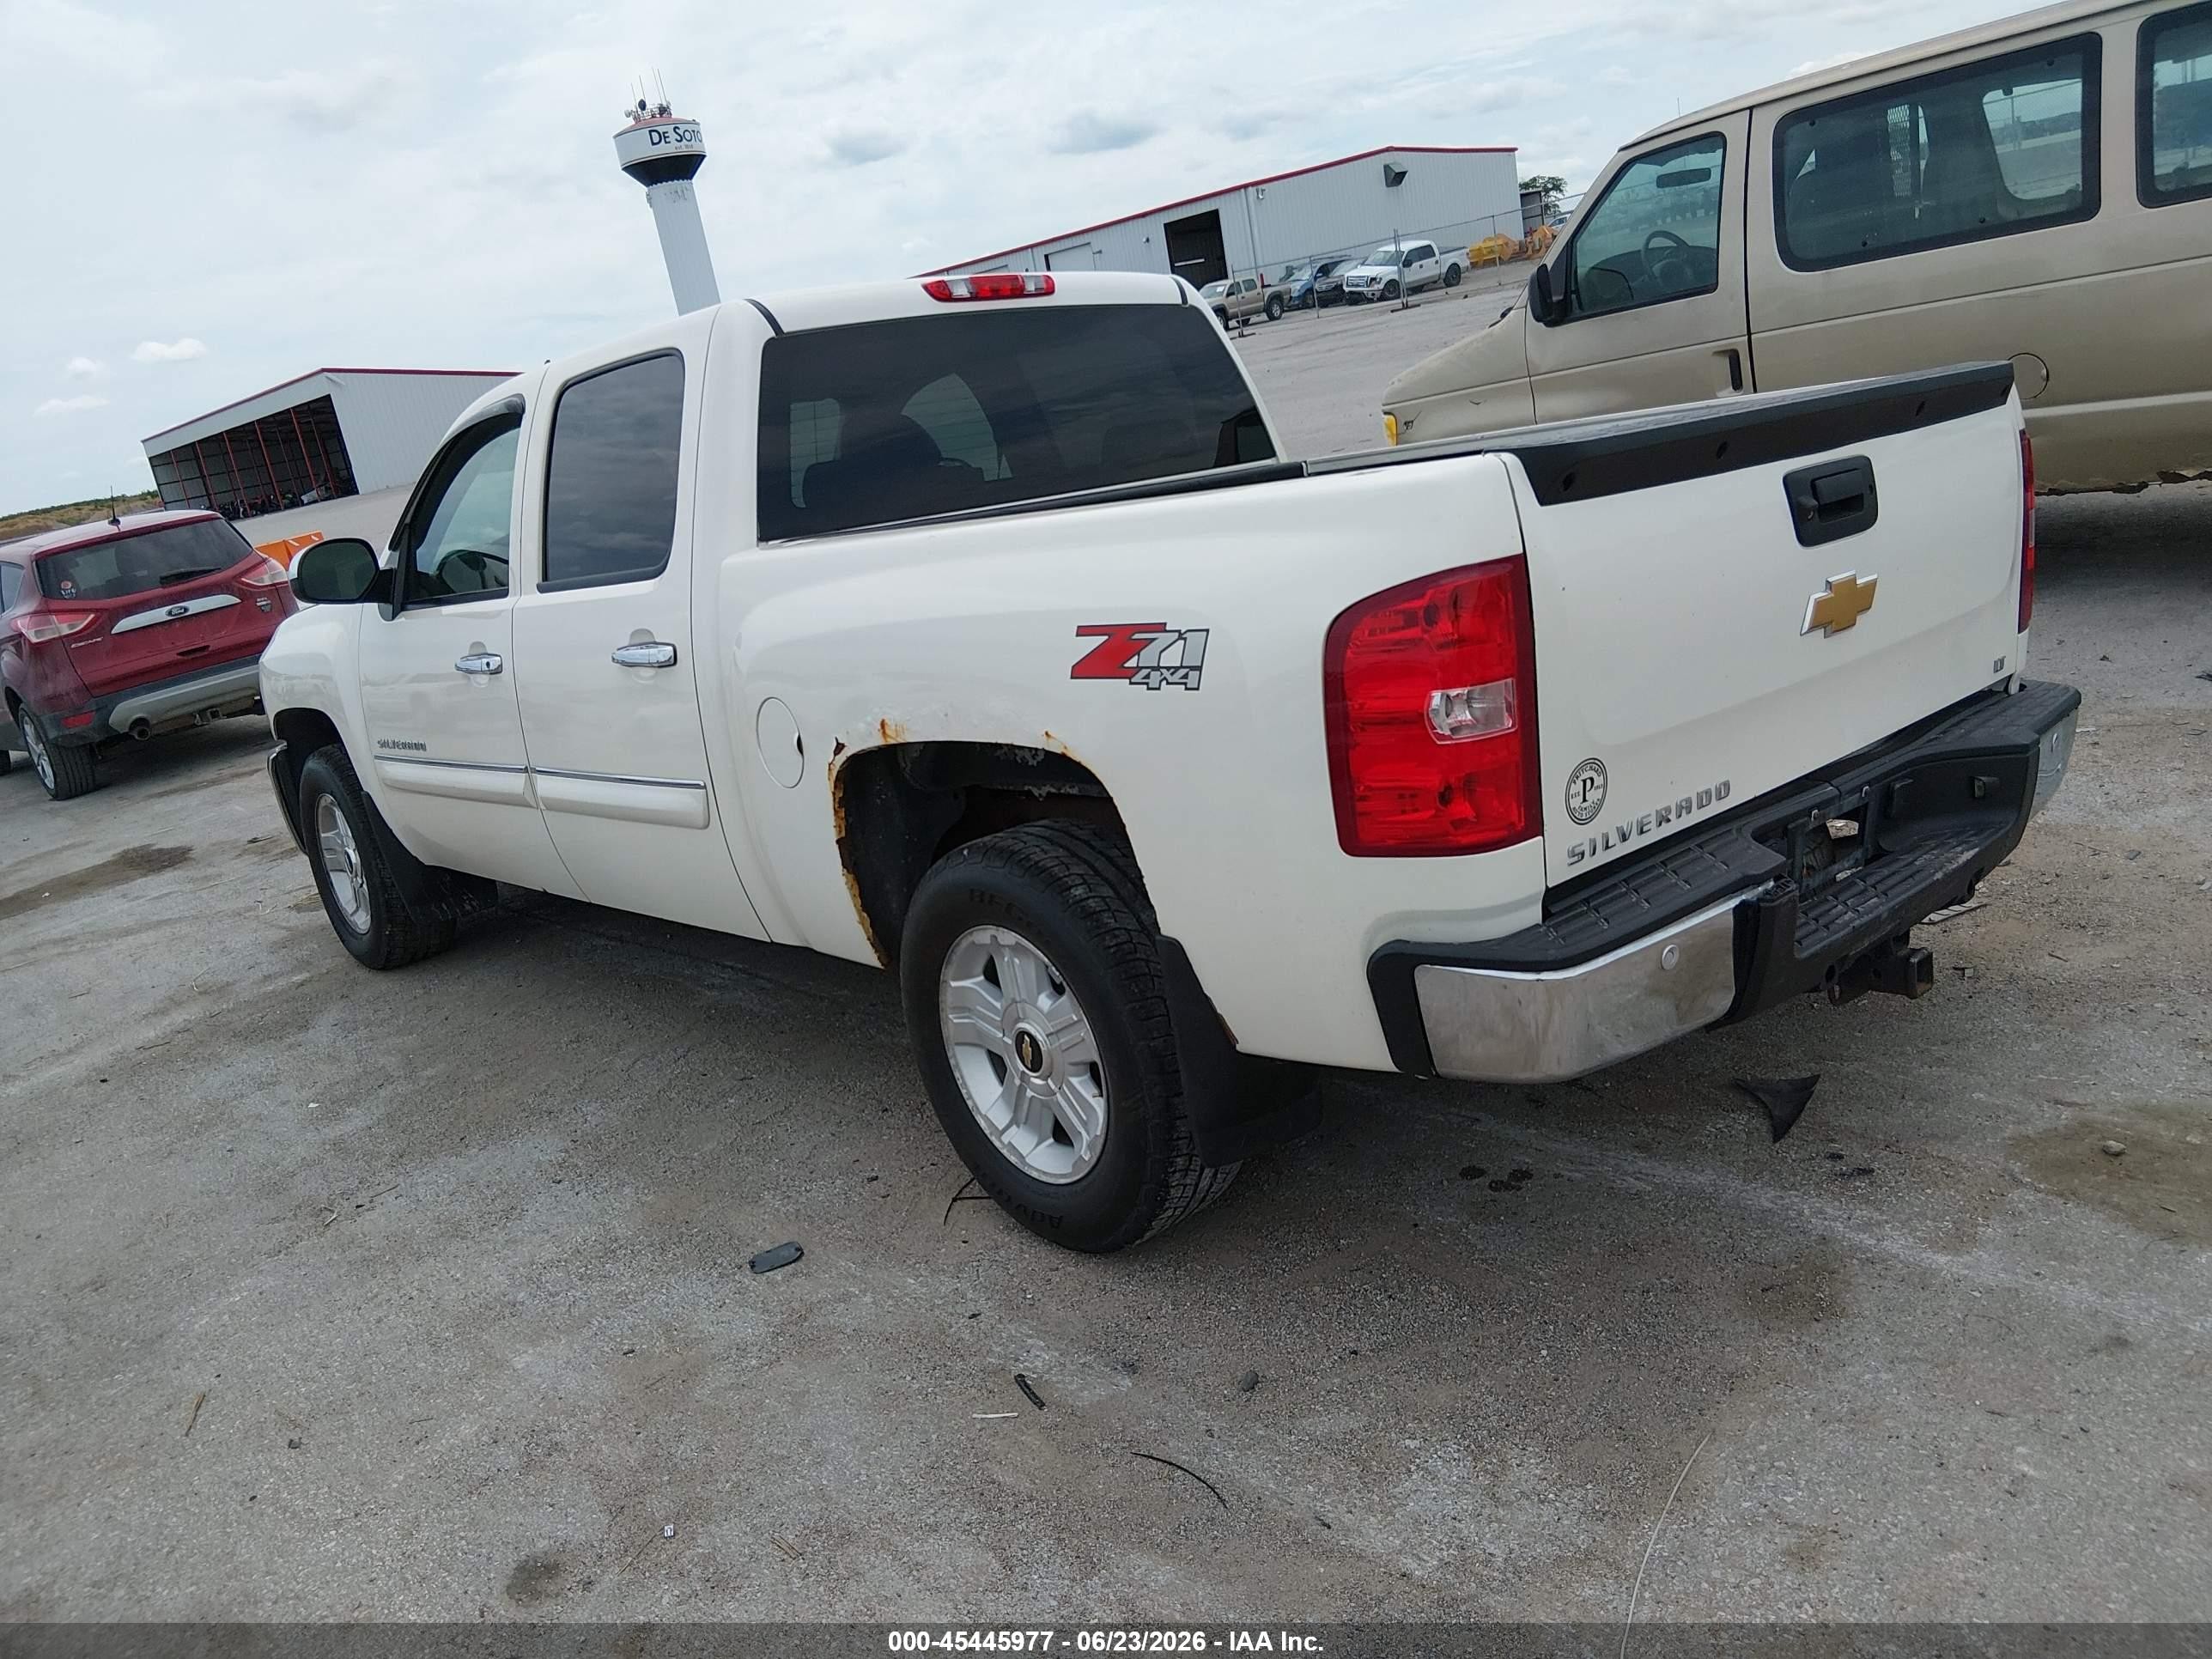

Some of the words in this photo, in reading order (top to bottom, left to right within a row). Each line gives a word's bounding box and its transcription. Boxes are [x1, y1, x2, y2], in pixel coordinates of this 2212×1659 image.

[1071, 622, 1210, 680] Z71
[1580, 775, 1595, 805] P
[1566, 779, 1732, 867] SILVERADO
